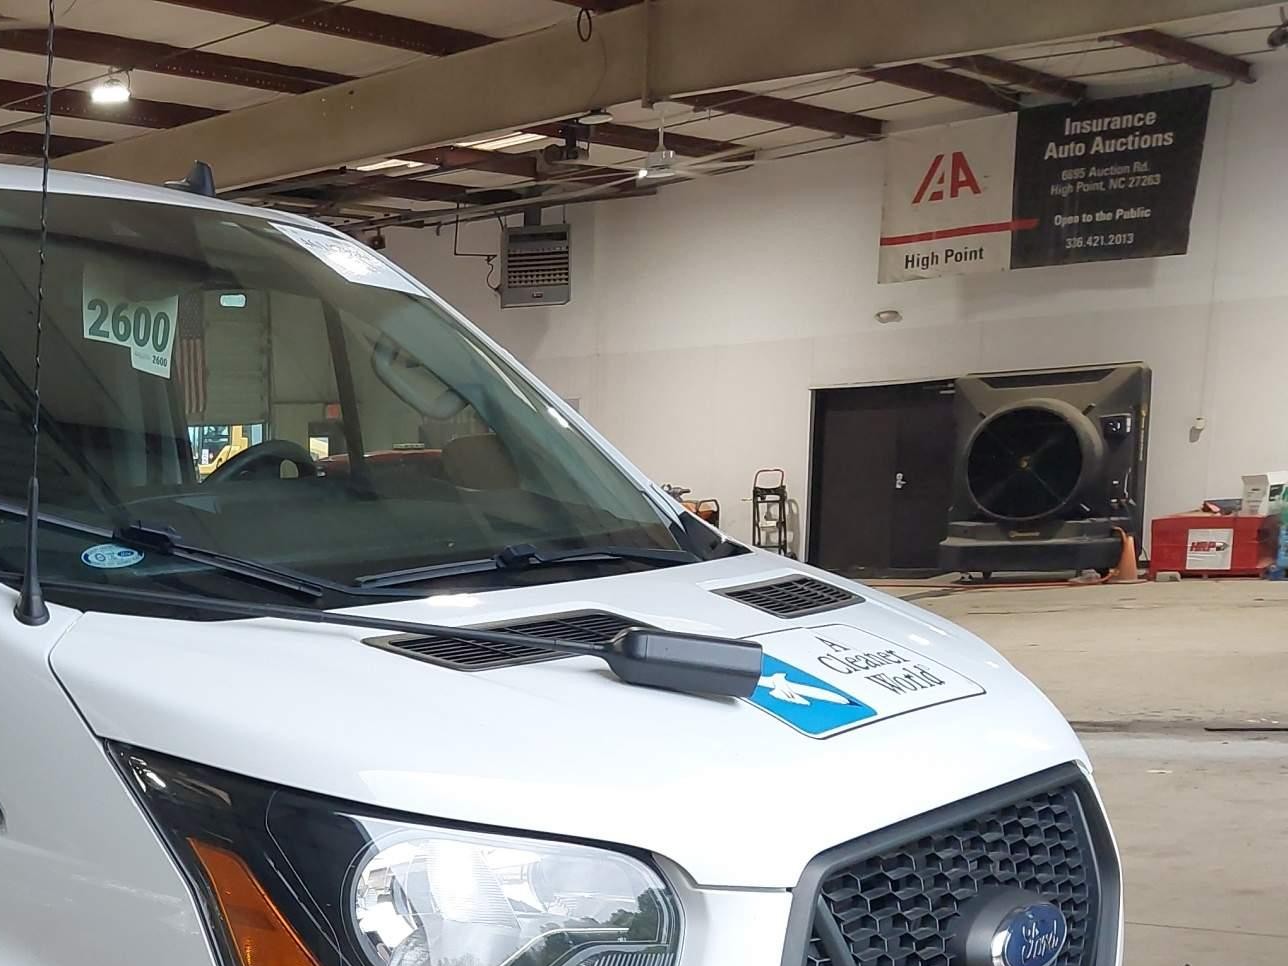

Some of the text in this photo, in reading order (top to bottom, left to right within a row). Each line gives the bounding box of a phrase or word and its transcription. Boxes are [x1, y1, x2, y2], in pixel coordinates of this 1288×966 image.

[1064, 111, 1157, 136] Insurance
[1044, 131, 1174, 160] Auto Auctions
[1088, 164, 1130, 178] Auction
[1050, 183, 1073, 197] High
[1109, 177, 1126, 190] NC
[1128, 174, 1161, 188] 27263
[1054, 206, 1151, 227] Open to the Public
[1065, 232, 1135, 249] 336.421.2013
[905, 246, 985, 271] High Point
[87, 298, 171, 353] 2600
[152, 355, 168, 368] 2600
[814, 635, 852, 653] A
[816, 648, 912, 675] Cleaner
[863, 664, 947, 696] World
[1021, 919, 1059, 965] Ford
